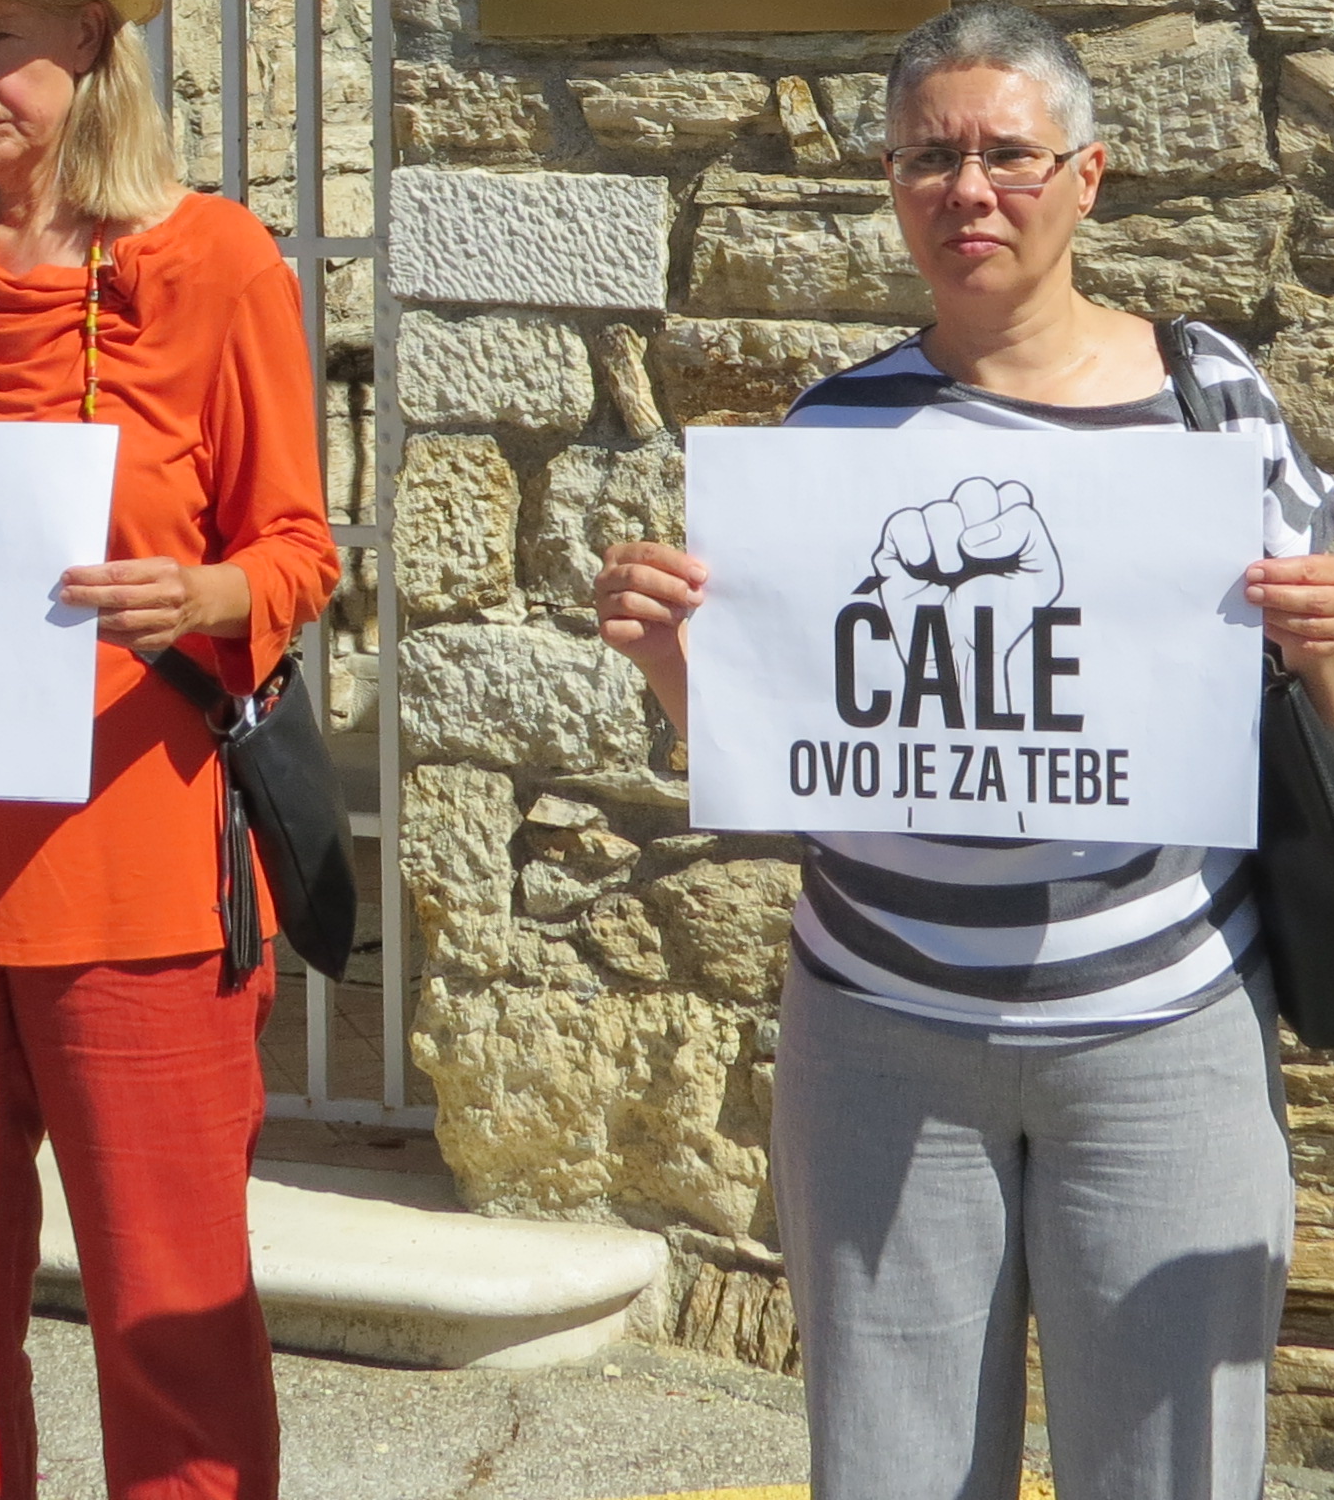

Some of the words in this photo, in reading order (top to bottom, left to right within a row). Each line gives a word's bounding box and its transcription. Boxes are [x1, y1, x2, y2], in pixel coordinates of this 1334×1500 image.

[834, 575, 1084, 732] ĆALE
[789, 739, 880, 798] OVO
[893, 742, 937, 800] JE
[949, 745, 1007, 802] ZA
[1019, 747, 1129, 806] TEBE
